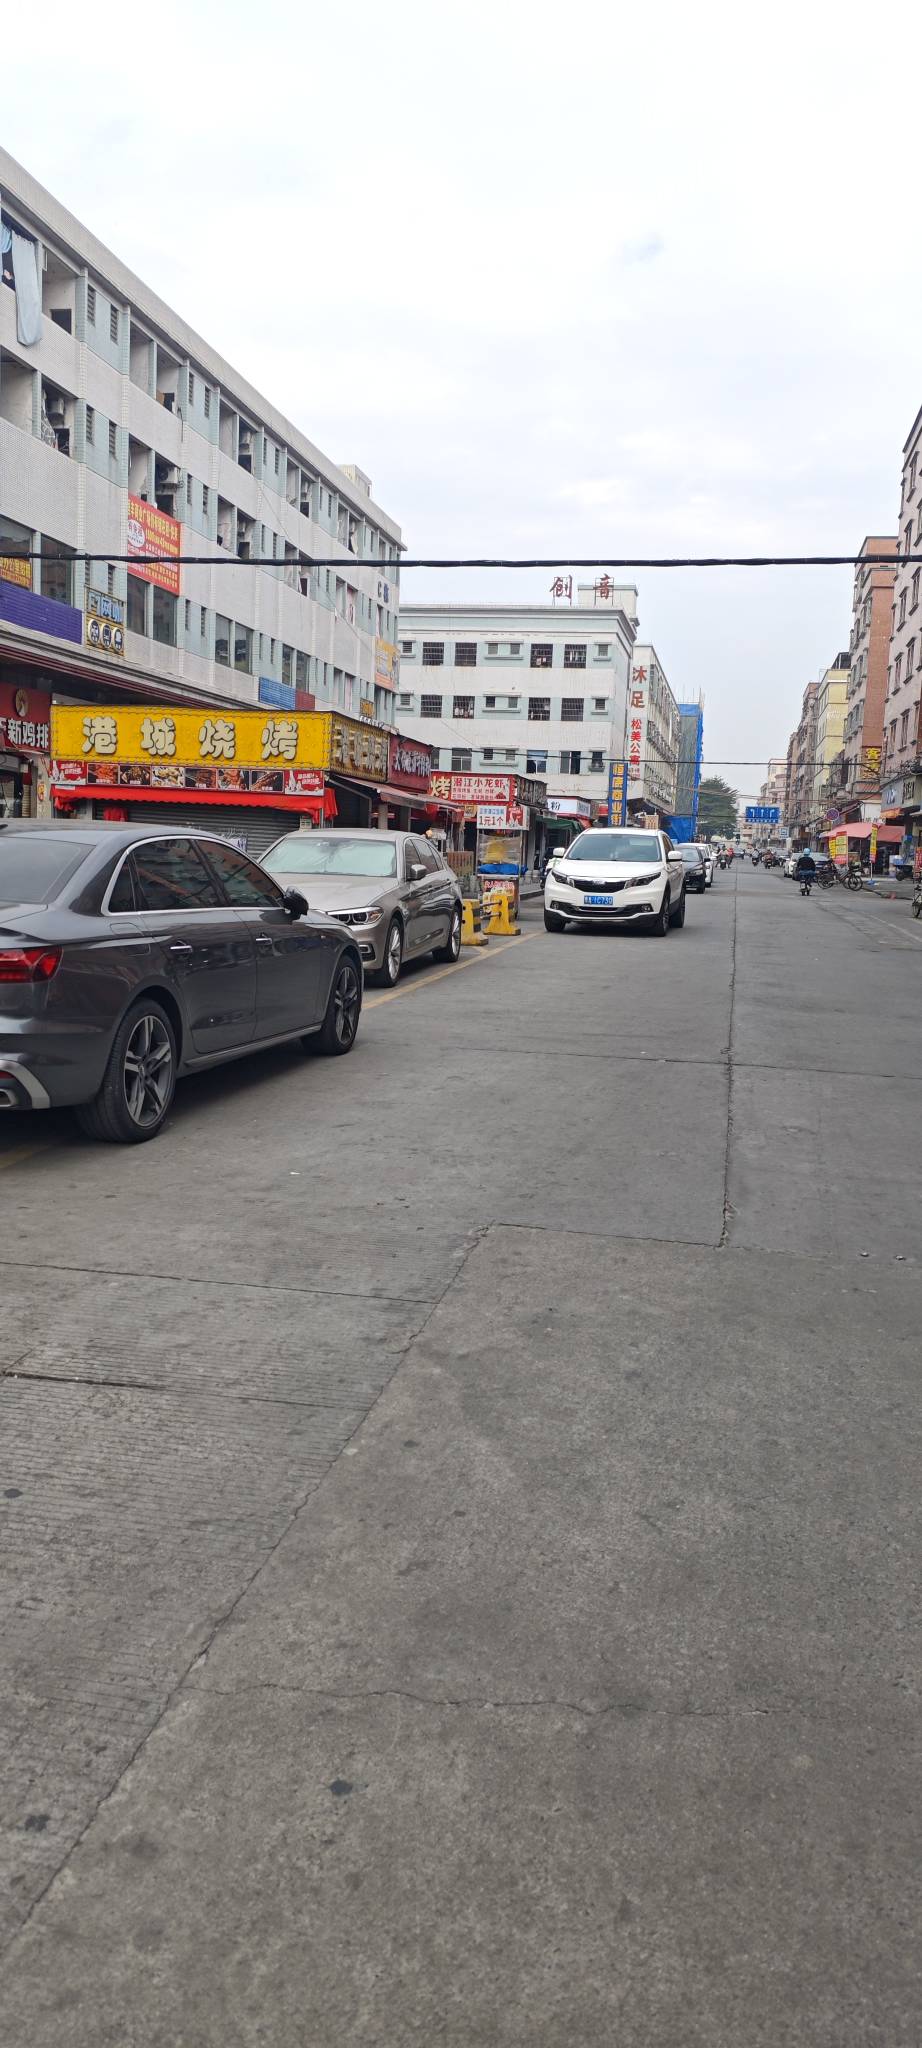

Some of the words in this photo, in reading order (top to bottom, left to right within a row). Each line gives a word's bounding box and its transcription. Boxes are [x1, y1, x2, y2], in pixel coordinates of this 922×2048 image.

[631, 665, 647, 709] 沐足
[81, 716, 298, 760] 港城烧烤
[430, 775, 452, 801] 烤
[479, 815, 504, 827] 1元1个
